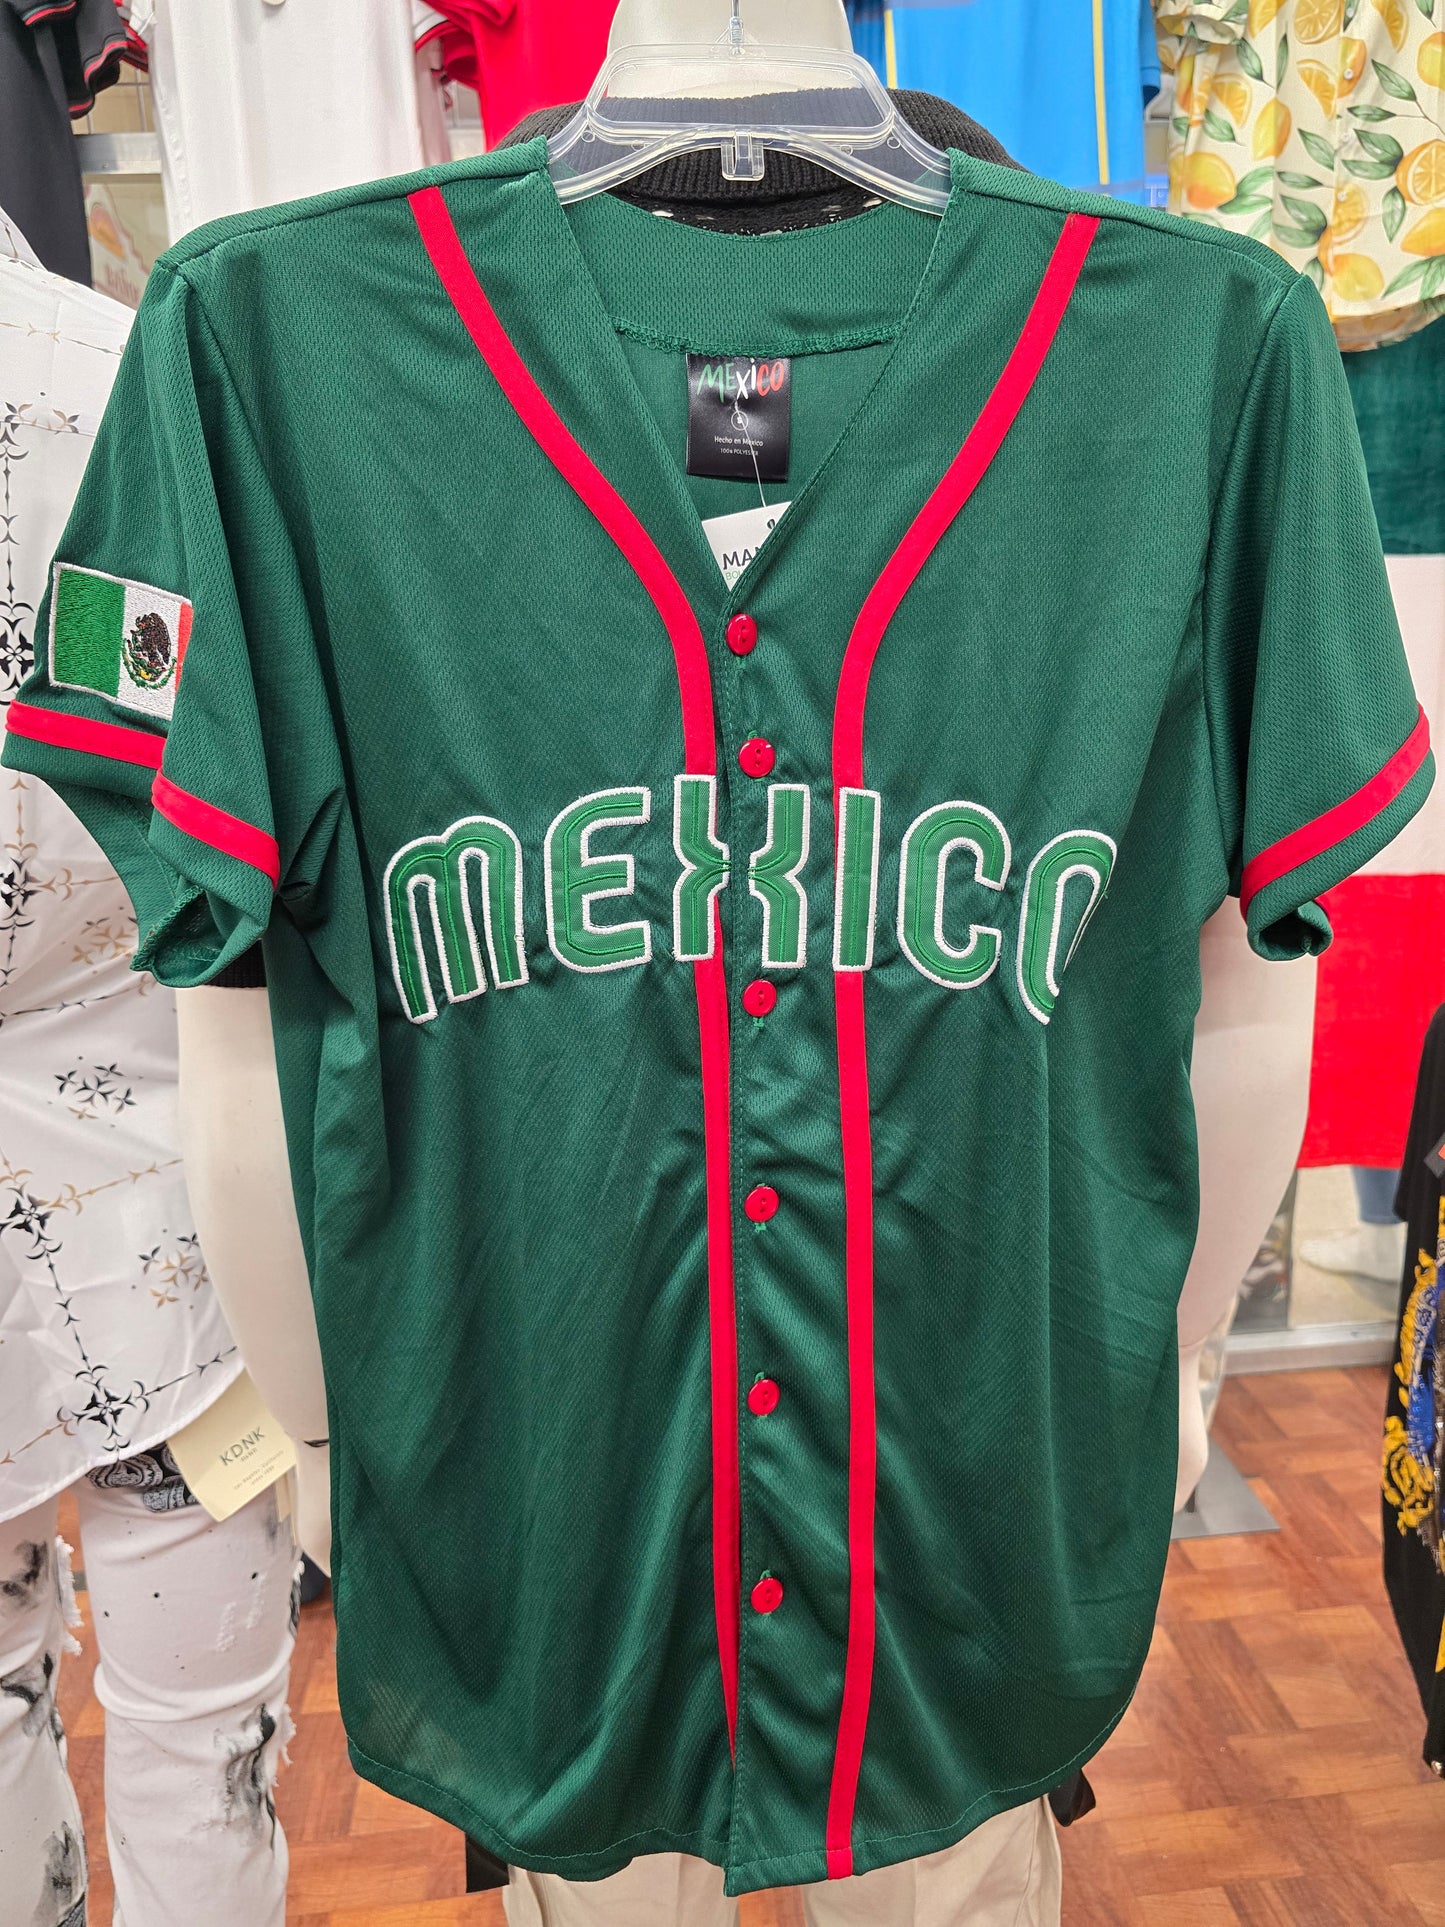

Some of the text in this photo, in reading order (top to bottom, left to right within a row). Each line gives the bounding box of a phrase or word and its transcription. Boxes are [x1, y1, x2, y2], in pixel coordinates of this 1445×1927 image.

[714, 435, 733, 444] Hecho
[383, 774, 1118, 1025] MEXICO
[218, 1426, 265, 1467] KDNK
